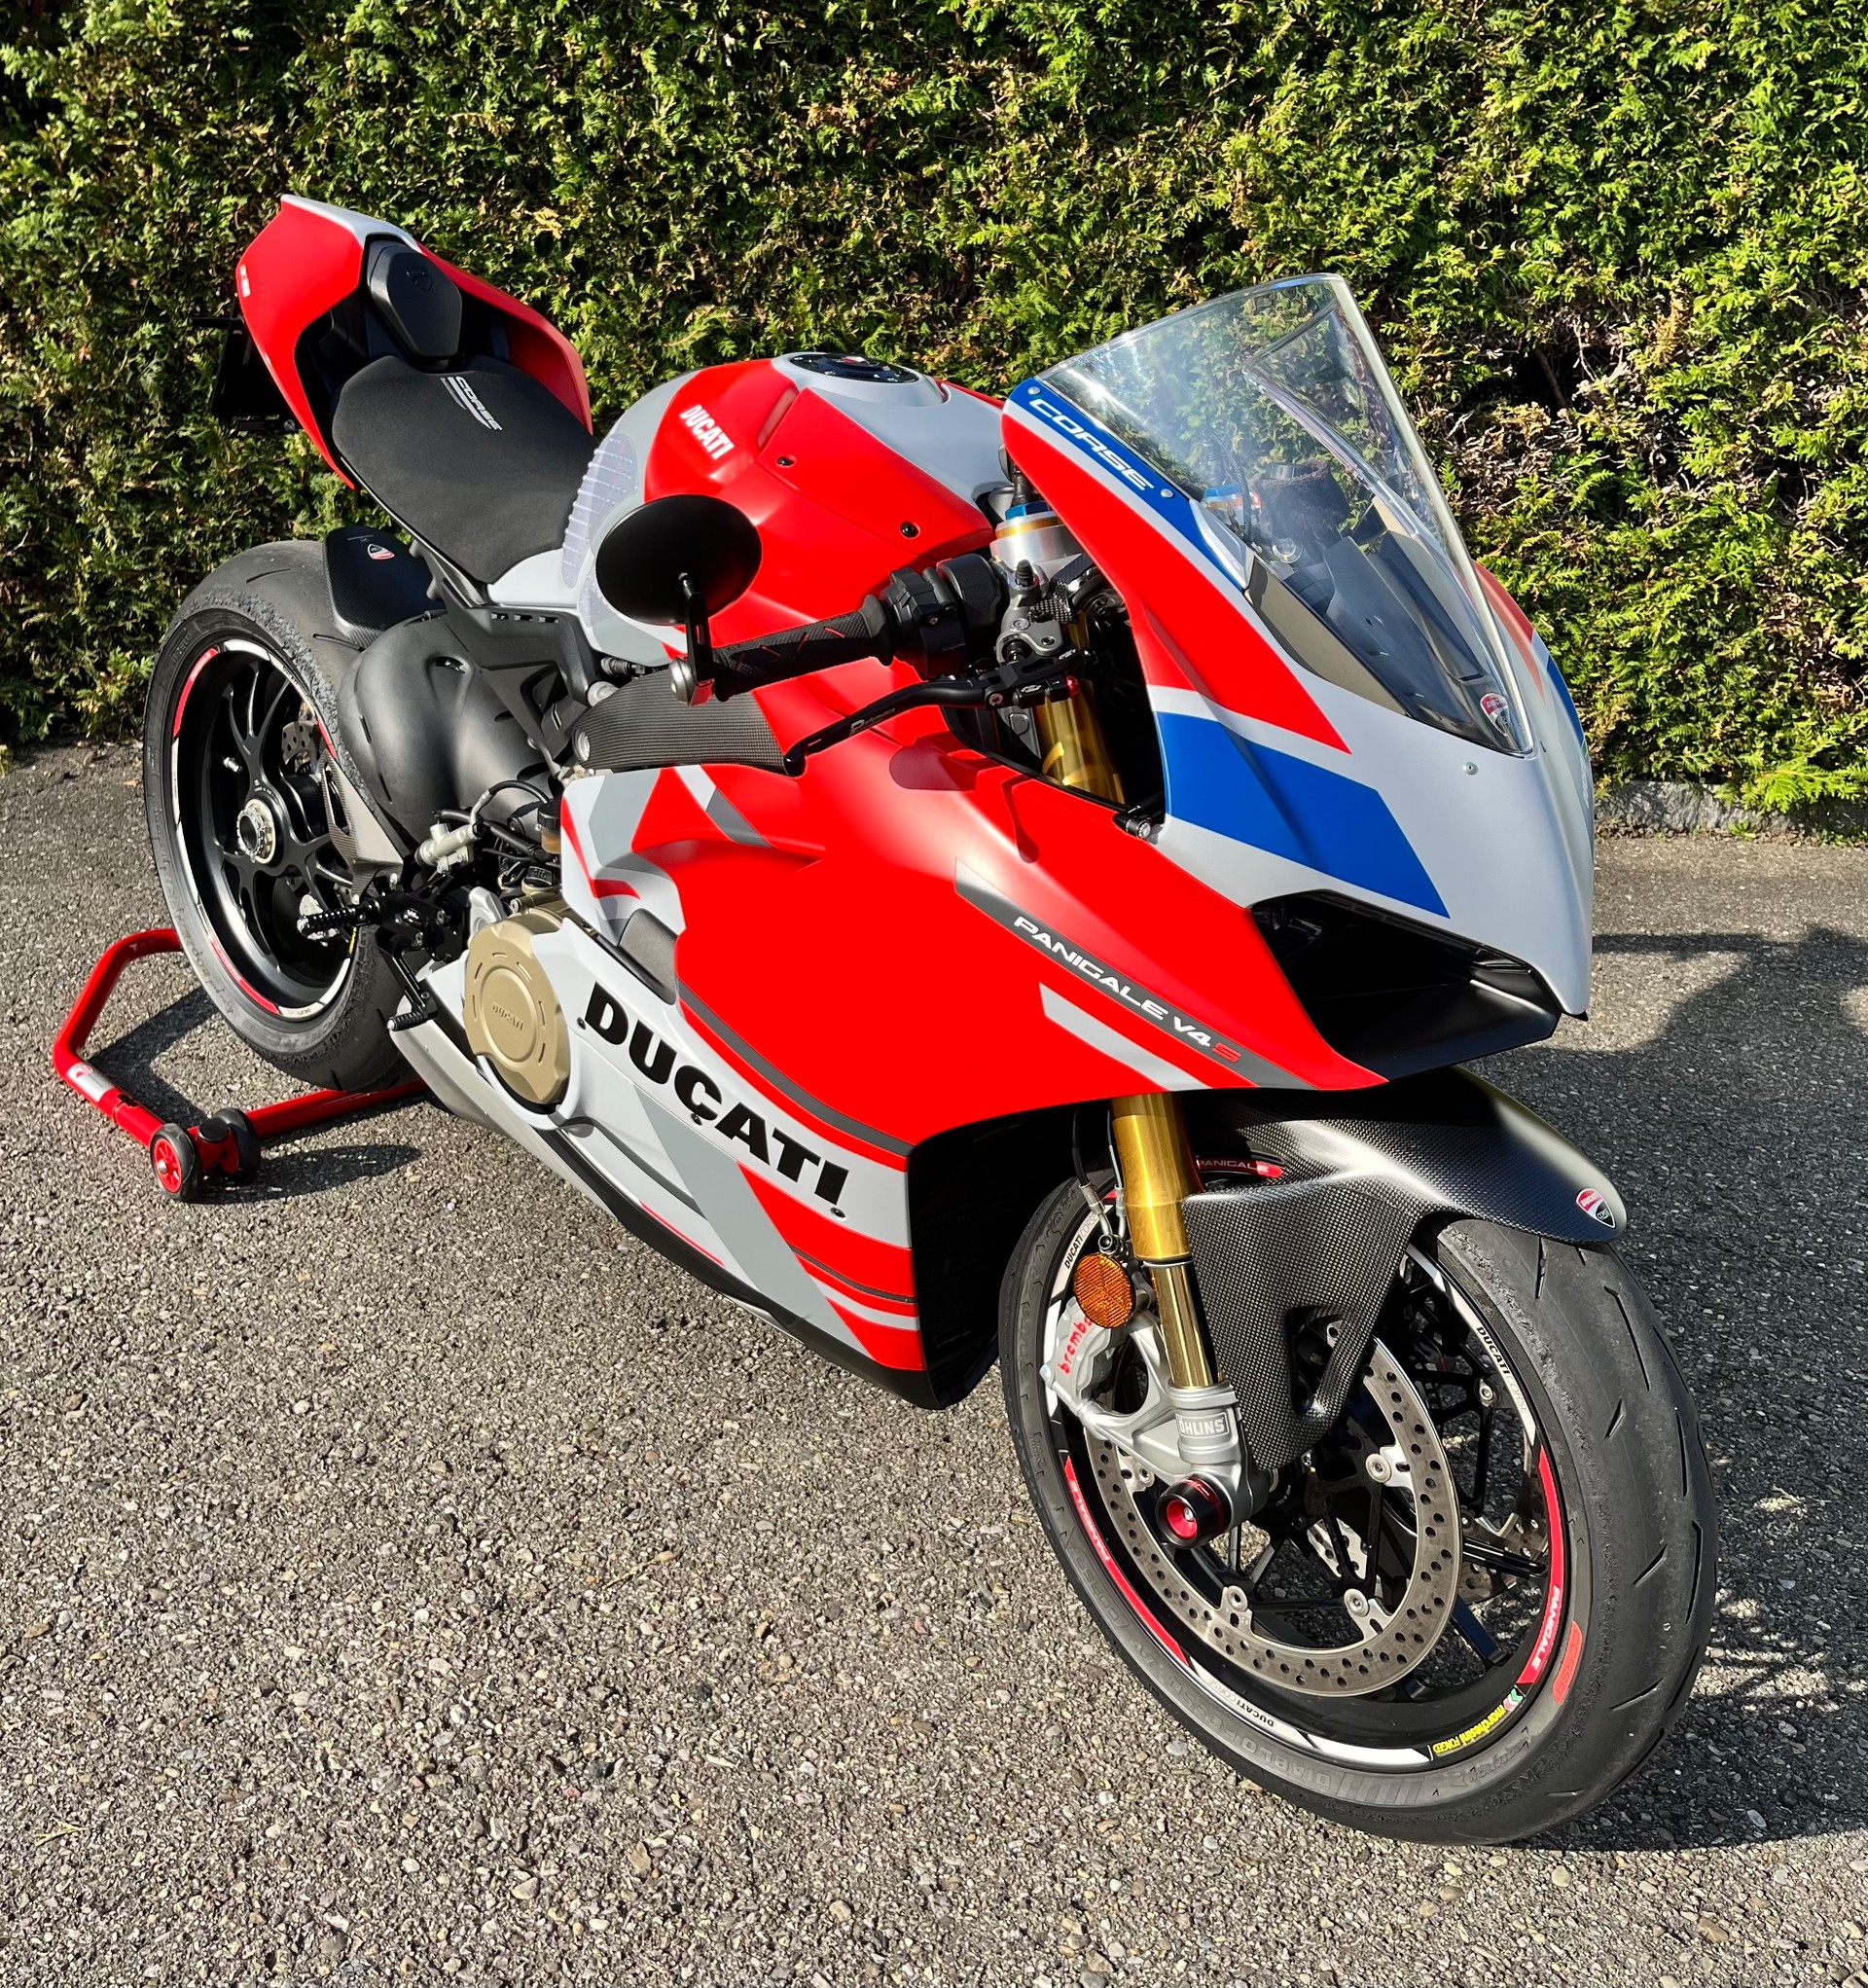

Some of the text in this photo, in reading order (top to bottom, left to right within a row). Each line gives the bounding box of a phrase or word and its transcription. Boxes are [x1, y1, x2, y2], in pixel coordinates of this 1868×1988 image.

[679, 404, 735, 460] DUCATI
[1029, 399, 1155, 490] CORSE
[1014, 917, 1168, 1020] PANIGALE
[585, 981, 849, 1206] DUCATI
[1197, 1159, 1269, 1174] PANIGALE
[1064, 1235, 1084, 1269] DUCATI
[1476, 1326, 1510, 1374] DUCATI
[1531, 1585, 1560, 1670] PANIGALE
[1237, 1699, 1275, 1727] DUCATI
[1432, 1704, 1506, 1753] marchesini FORGED
[1241, 1737, 1331, 1789] DIABLO
